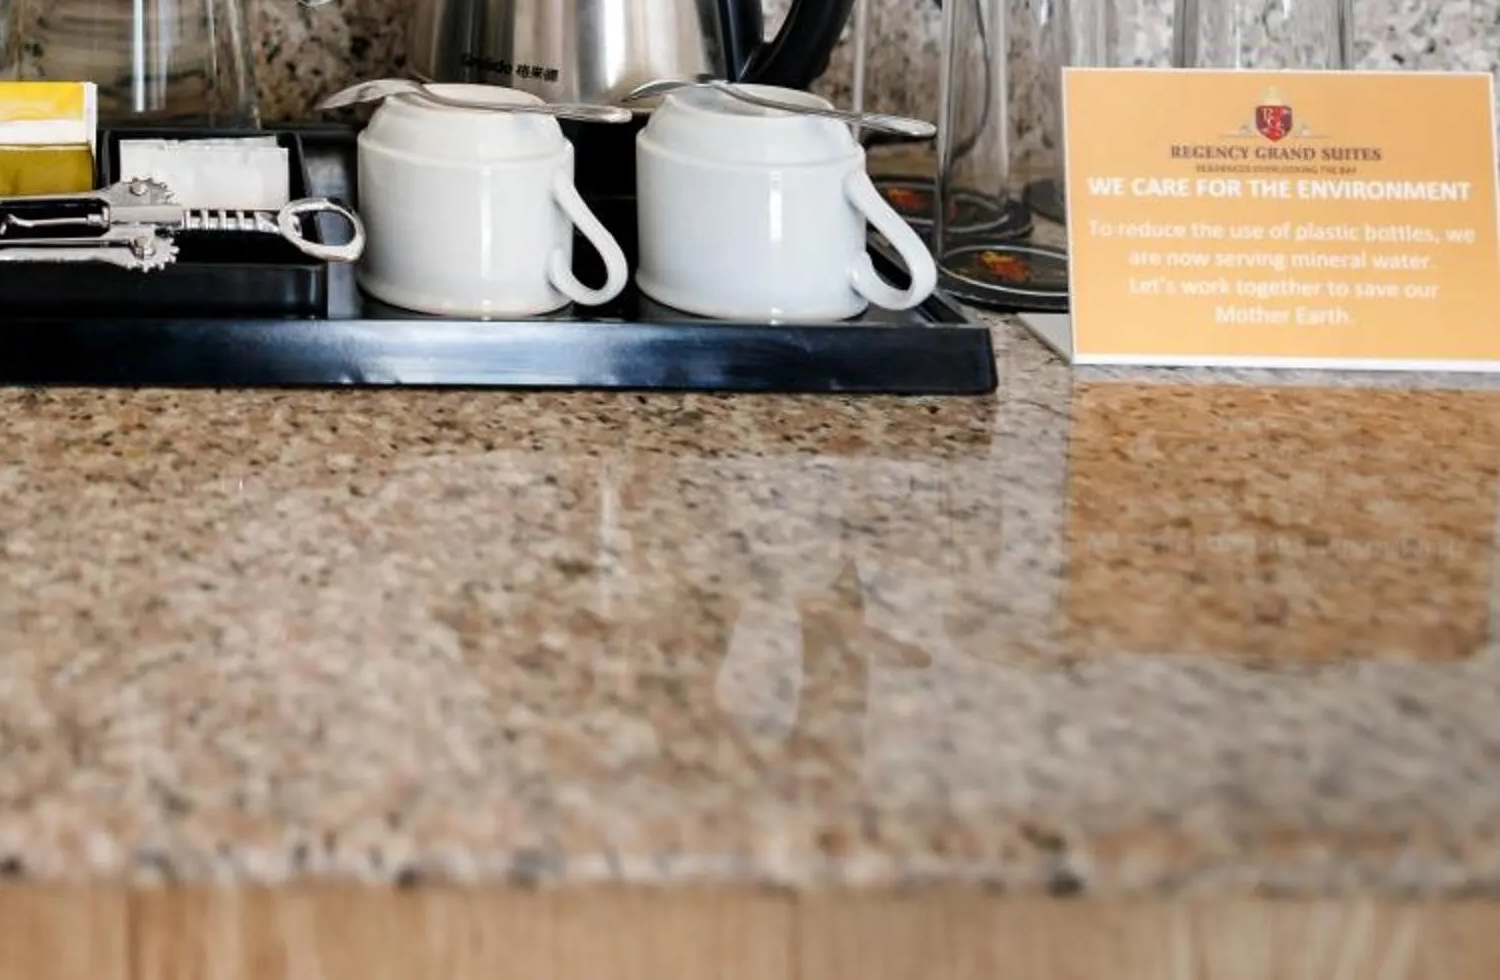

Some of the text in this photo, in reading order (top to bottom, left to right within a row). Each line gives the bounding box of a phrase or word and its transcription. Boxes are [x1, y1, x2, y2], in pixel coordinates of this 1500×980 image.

[1171, 145, 1382, 162] REGENCY GRAND SUITES
[1087, 177, 1471, 201] WE CARE FOR THE ENVIRONMENT
[1089, 220, 1476, 245] To reduce the use of plastic bottles, we
[1128, 250, 1438, 271] are now serving mineral water.
[1181, 277, 1229, 295] work
[1236, 277, 1321, 300] together
[1327, 280, 1349, 297] to
[1356, 284, 1400, 298] save
[1404, 284, 1440, 299] our
[1215, 304, 1290, 324] Mother
